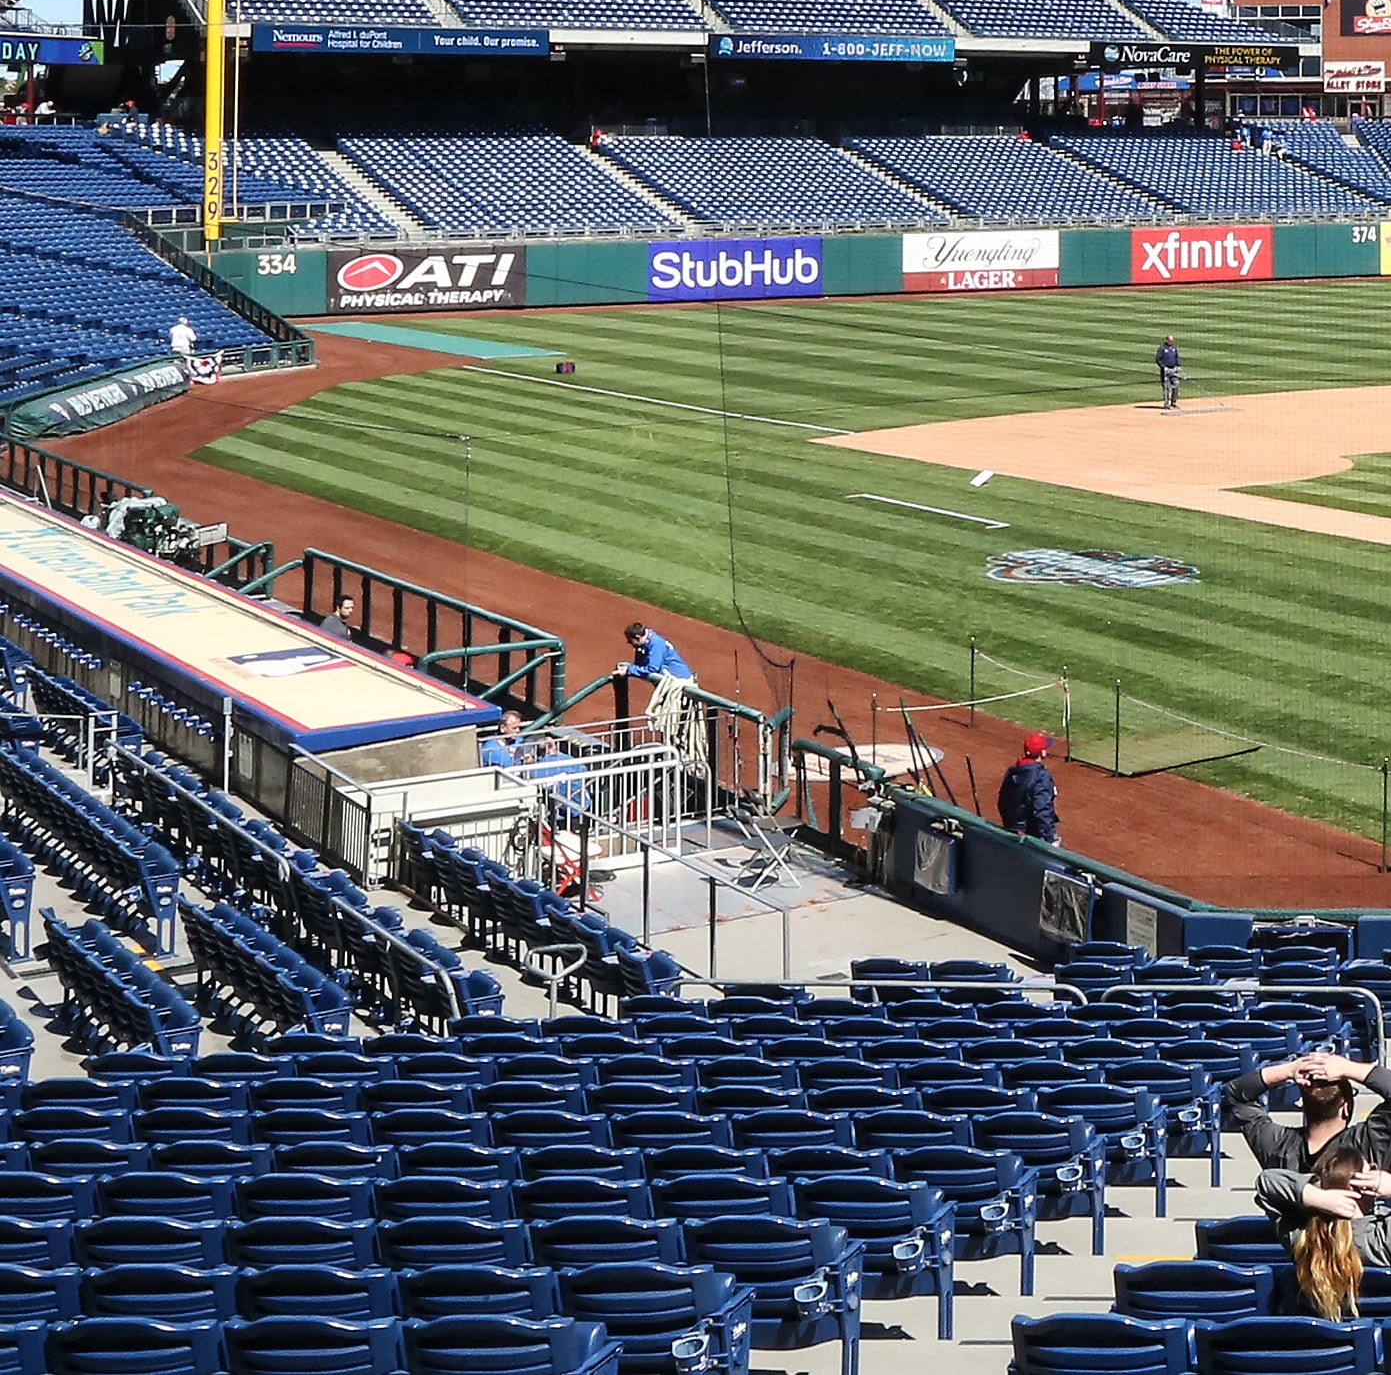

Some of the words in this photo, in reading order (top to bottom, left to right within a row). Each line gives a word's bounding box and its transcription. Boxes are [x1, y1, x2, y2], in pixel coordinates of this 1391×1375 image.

[272, 29, 323, 42] Nemours
[327, 29, 351, 40] Alfred
[359, 30, 388, 40] duPont
[327, 39, 358, 50] Hospital
[360, 40, 370, 49] for
[372, 39, 403, 50] Children
[434, 35, 455, 47] Your
[457, 35, 482, 47] child.
[484, 36, 498, 47] Our
[500, 36, 540, 49] promise.
[2, 42, 40, 61] DAY
[821, 41, 949, 59] 1-800-JEFF-NOW
[1120, 45, 1192, 63] NovaCare
[1214, 47, 1230, 56] THE
[1231, 47, 1262, 57] POWER
[1263, 47, 1273, 56] OF
[1204, 55, 1243, 65] PHYSICAL
[1244, 55, 1282, 65] THERAPY
[1326, 80, 1350, 90] ALLEY
[1355, 80, 1382, 90] STORE
[1352, 225, 1378, 244] 374
[922, 235, 1042, 271] Yuengling
[1140, 230, 1263, 279] xfinity
[257, 254, 297, 276] 334
[395, 253, 516, 289] ATI
[650, 249, 820, 290] StubHub
[947, 270, 1017, 290] LAGER
[339, 290, 425, 308] PHYSICAL
[426, 288, 506, 306] THERAPY
